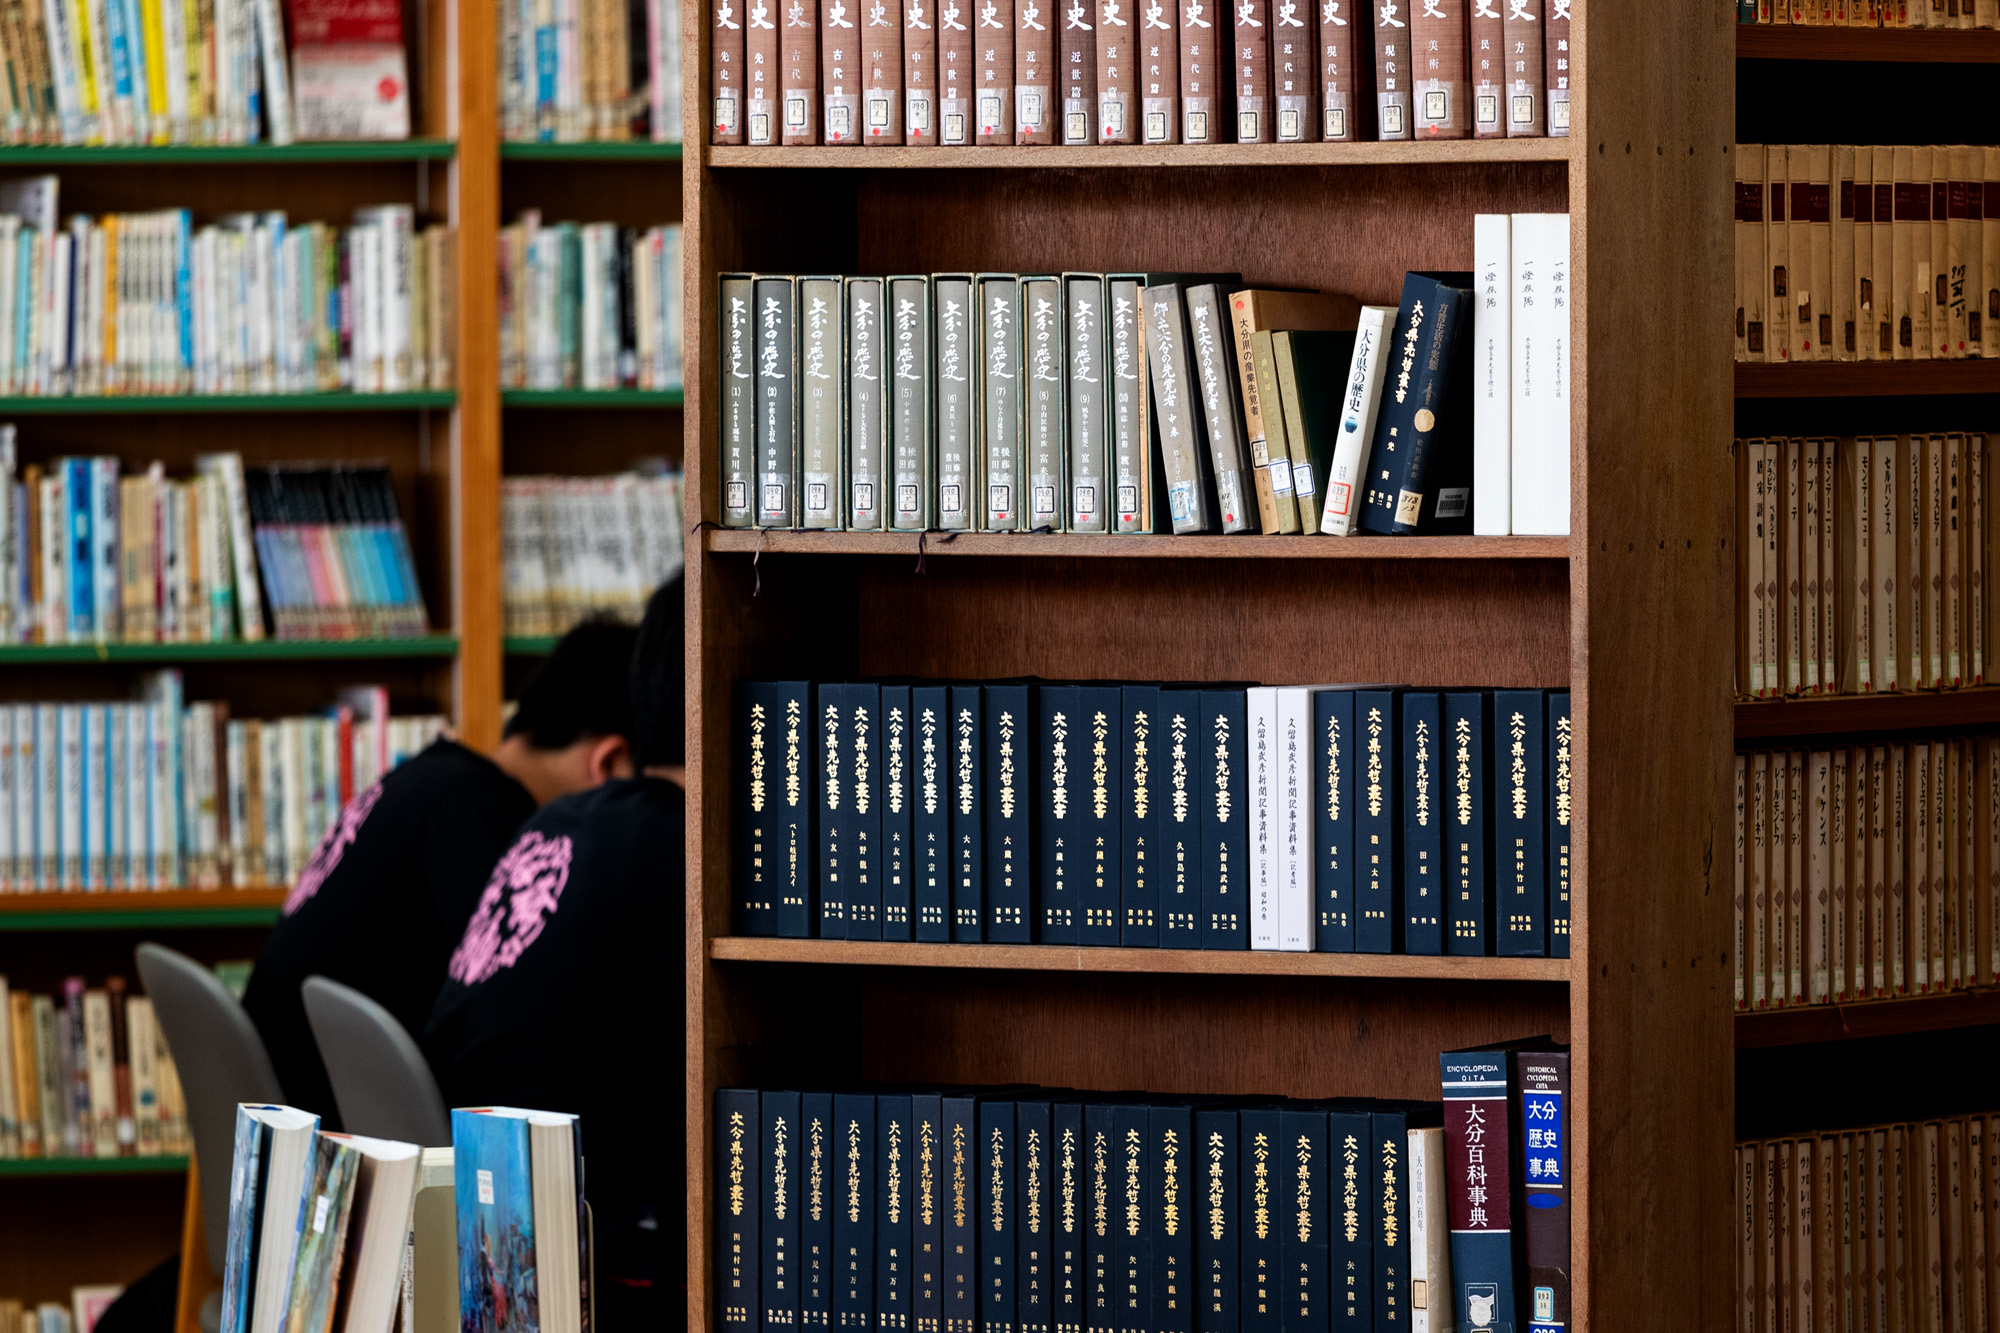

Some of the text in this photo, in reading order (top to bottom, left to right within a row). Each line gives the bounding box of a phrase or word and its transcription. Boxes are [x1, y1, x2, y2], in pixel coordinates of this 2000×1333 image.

[718, 0, 739, 29] 史
[943, 0, 966, 30] 史
[1022, 0, 1045, 30] 史
[1103, 0, 1127, 26] 史
[1185, 0, 1211, 28] 史
[1279, 0, 1303, 27] 史
[1380, 0, 1405, 27] 史
[730, 297, 749, 396] 大分の歴史 (1)
[761, 297, 785, 397] 大分の歴史 (2)
[807, 298, 830, 379] 大分の歴史
[854, 299, 877, 401] 大分の歴史 (4)
[896, 299, 920, 398] 大分の歴史 (5)
[942, 300, 966, 406] 大分の歴史 (6)
[989, 297, 1014, 396] 大分の歴史 (7)
[1034, 299, 1058, 381] 大分の歴史
[1074, 300, 1098, 382] 大分の歴史
[1113, 297, 1137, 379] 大分の歴史
[1152, 303, 1176, 408] 郷土大分の先覚者
[1195, 306, 1218, 410] 郷土大分の先覚者
[1239, 317, 1259, 416] 大分県の産業先覚者
[1348, 329, 1373, 413] 大分県の歴史
[1395, 300, 1425, 403] 大分県先哲叢書
[813, 387, 822, 397] (3)
[1039, 391, 1048, 401] (8)
[1080, 394, 1089, 403] (9)
[1401, 494, 1419, 504] 818
[1883, 456, 1892, 536] セルバンテス
[751, 704, 765, 811] 大分県先哲叢書
[786, 699, 800, 806] 大分県先哲叢書
[825, 705, 840, 809] 大分県先哲叢書
[854, 707, 870, 814] 大分県先哲叢書
[889, 707, 903, 813] 大分県先哲叢書
[922, 708, 937, 814] 大分県先哲叢書
[959, 709, 973, 814] 大分県先哲叢書
[1000, 712, 1015, 818] 大分県先哲叢書
[1053, 712, 1068, 819] 大分県先哲叢書
[1093, 711, 1108, 818] 大分県先哲叢書
[1134, 711, 1149, 818] 大分県先哲叢書
[1172, 714, 1188, 822] 大分県先哲叢書
[1215, 714, 1231, 822] 大分県先哲叢書
[1258, 717, 1267, 854] 久留島武彦新聞記事資料集
[1288, 718, 1297, 855] 久留島武彦新聞記事資料集
[1328, 716, 1340, 820] 大分県先哲叢書
[1368, 708, 1382, 816] 大分県先哲叢書
[1416, 720, 1429, 826] 大分県先哲叢書
[1456, 718, 1472, 825] 大分県先哲叢書
[1511, 712, 1527, 819] 大分県先哲叢書
[1556, 715, 1570, 826] 大分県先哲叢書
[1529, 1101, 1557, 1120] 大分
[1529, 1129, 1557, 1148] 歴史
[1534, 1083, 1549, 1091] OITA
[730, 1112, 744, 1215] 大分県先哲叢書
[775, 1117, 787, 1219] 大分県先哲叢書
[810, 1118, 822, 1220] 大分県先哲叢書
[848, 1120, 860, 1222] 大分県先哲叢書
[888, 1121, 901, 1223] 大分県先哲叢書
[921, 1121, 933, 1225] 大分県先哲叢書
[953, 1124, 965, 1226] 大分県先哲叢書
[991, 1128, 1003, 1231] 大分県先哲叢書
[1028, 1129, 1040, 1233] 大分県先哲叢書
[1062, 1129, 1074, 1232] 大分県先哲叢書
[1094, 1132, 1107, 1236] 大分県先哲叢書
[1126, 1129, 1140, 1235] 大分県先哲叢書
[1164, 1129, 1179, 1235] 大分県先哲叢書
[1209, 1132, 1225, 1240] 大分県先哲叢書
[1254, 1133, 1269, 1239] 大分県先哲叢書
[1297, 1135, 1312, 1242] 大分県先哲叢書
[1344, 1135, 1358, 1241] 大分県先哲叢書
[1383, 1140, 1398, 1246] 大分県先哲叢書
[1465, 1104, 1488, 1227] 大分百科事典
[1530, 1157, 1559, 1177] 事典
[1536, 1290, 1551, 1299] 092
